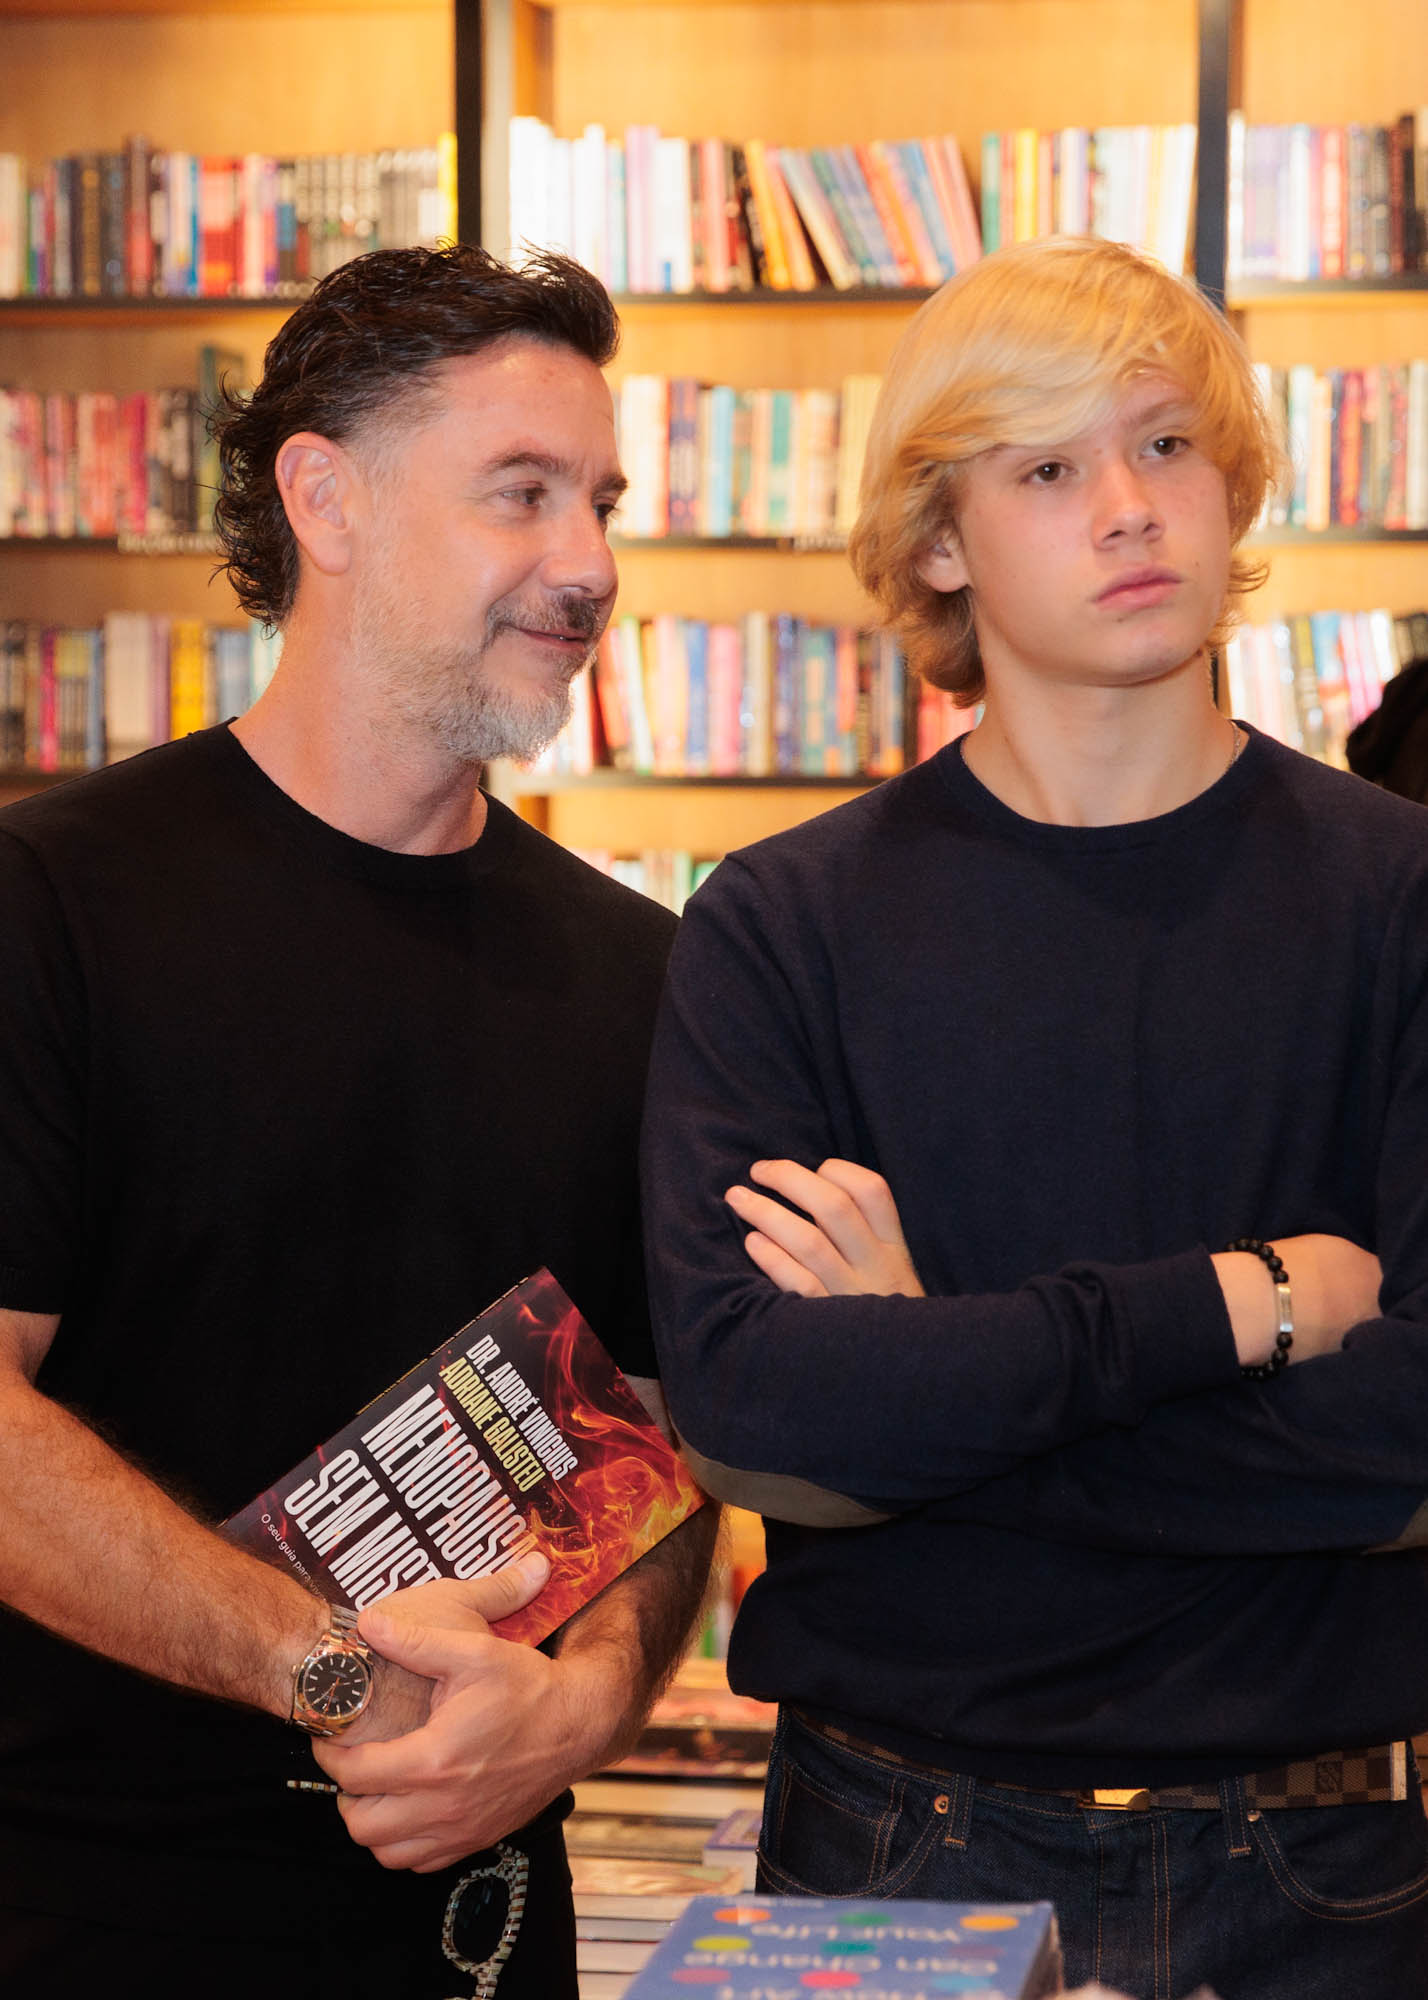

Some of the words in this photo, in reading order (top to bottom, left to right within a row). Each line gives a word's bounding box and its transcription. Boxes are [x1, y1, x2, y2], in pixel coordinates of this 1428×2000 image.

[438, 1357, 502, 1430] ADRIANE
[482, 1417, 546, 1492] GALISTEU
[465, 1334, 500, 1375] DR.
[485, 1361, 540, 1421] ANDRÉ
[518, 1406, 578, 1481] VINÍCIUS
[261, 1513, 271, 1524] O
[268, 1523, 282, 1542] seu
[278, 1541, 297, 1562] guia
[293, 1561, 311, 1582] para
[284, 1449, 390, 1557] SEM
[361, 1383, 539, 1580] MENOPAUSA
